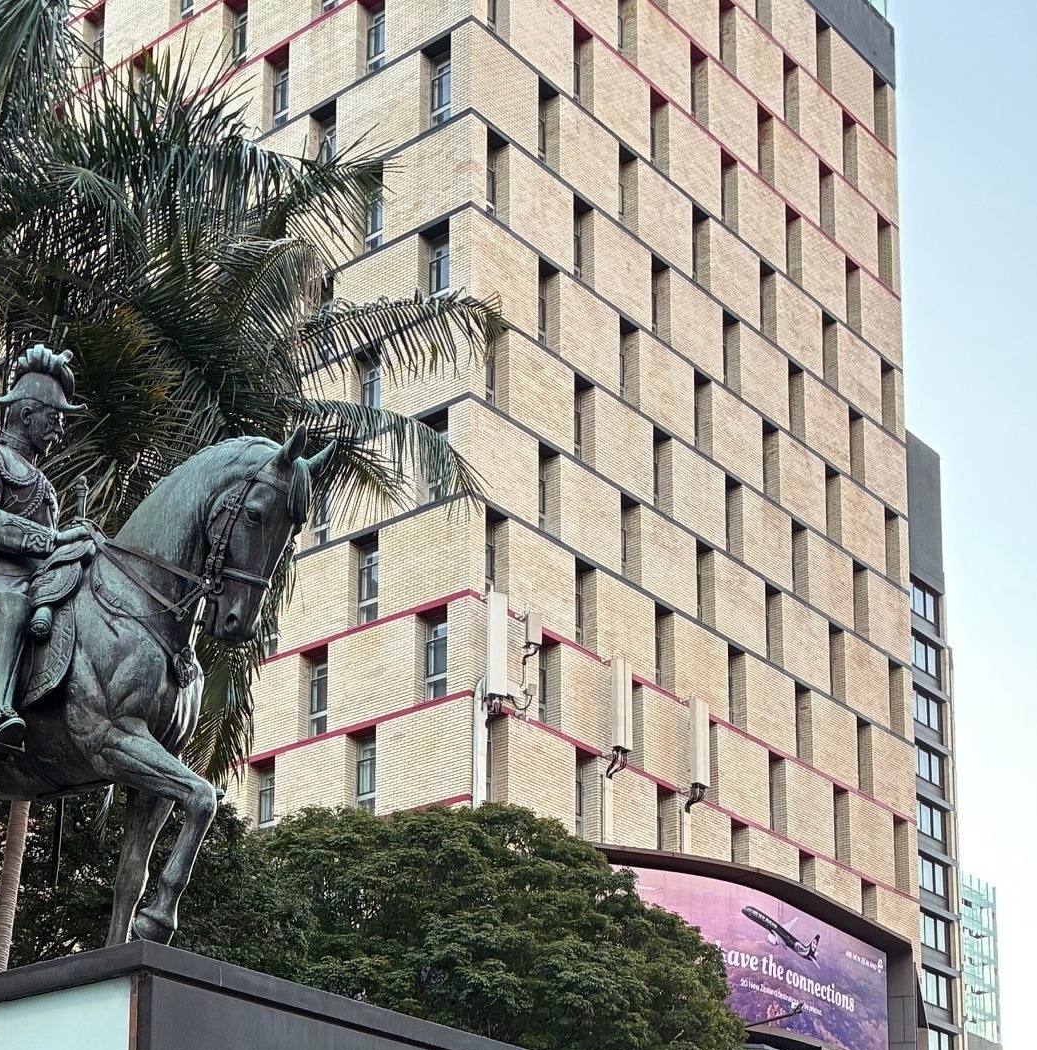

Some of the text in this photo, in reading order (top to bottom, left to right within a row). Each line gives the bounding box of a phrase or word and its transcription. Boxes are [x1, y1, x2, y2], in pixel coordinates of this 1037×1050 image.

[740, 978, 748, 988] 20
[748, 980, 760, 991] New
[760, 984, 778, 998] Zealand
[762, 954, 784, 981] the
[786, 969, 855, 1013] connections
